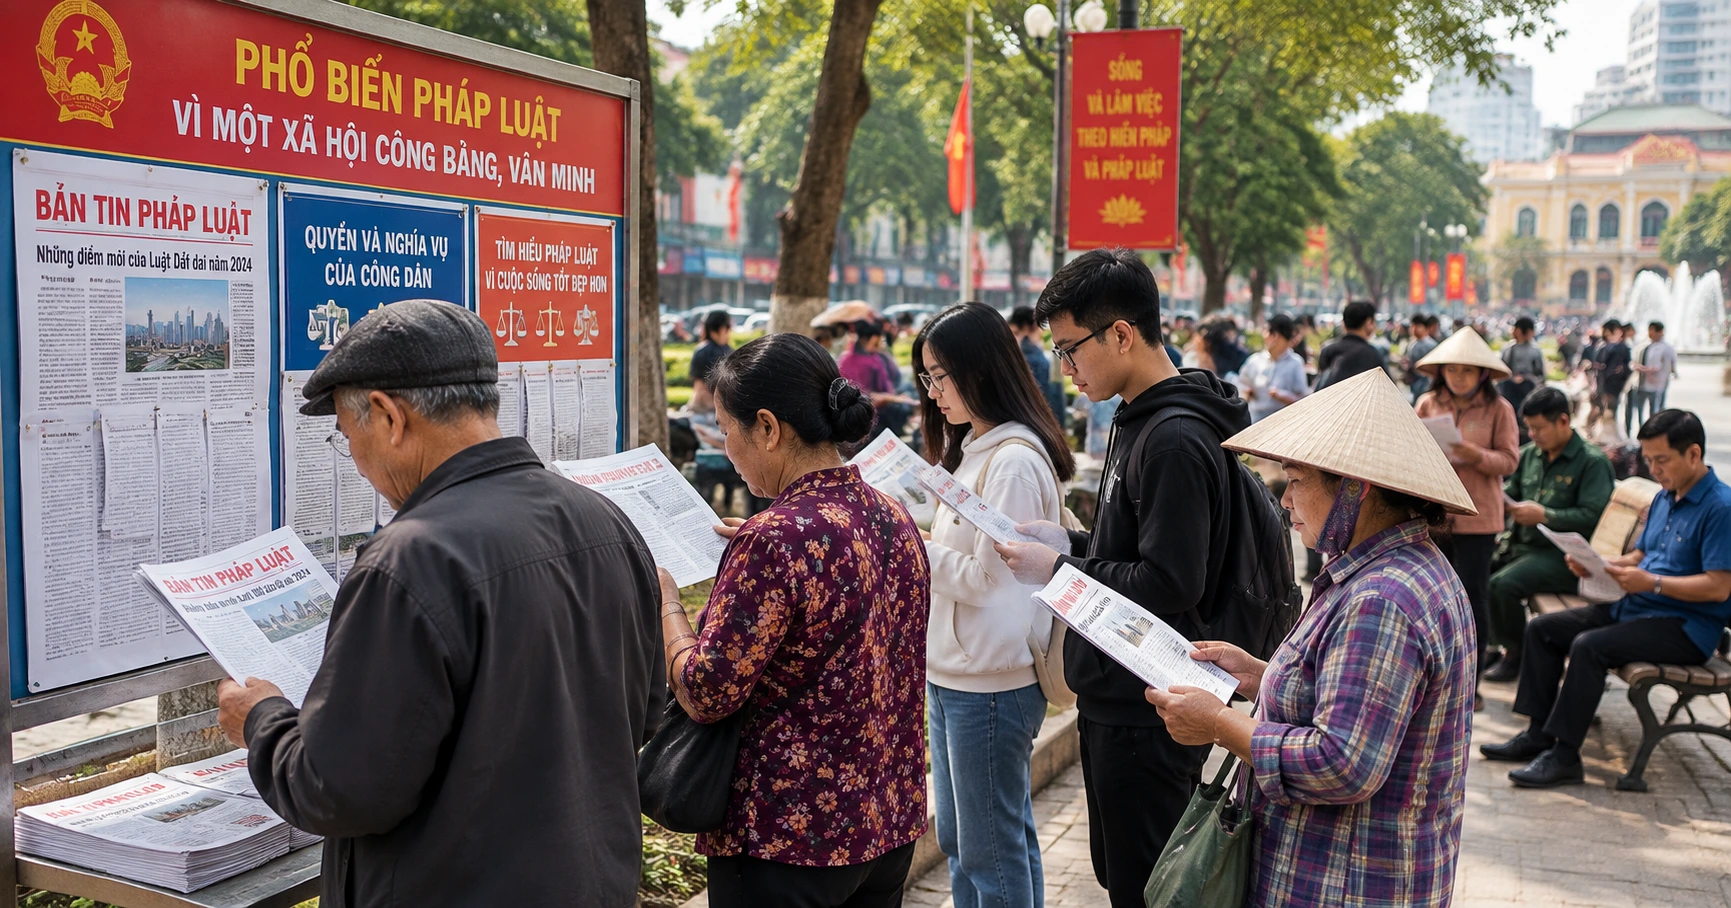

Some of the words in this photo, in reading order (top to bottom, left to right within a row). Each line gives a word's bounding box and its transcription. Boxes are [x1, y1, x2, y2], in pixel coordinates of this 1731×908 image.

[414, 77, 492, 129] PHÁP
[500, 95, 562, 149] LUẬT
[172, 93, 202, 138] VÌ
[212, 102, 273, 154] MỘT
[282, 113, 318, 155] XÃ
[326, 121, 367, 169] HỘI
[375, 129, 436, 172] CÔNG
[551, 162, 596, 195] MINH
[1076, 127, 1107, 149] THEO
[93, 194, 131, 227] TIN
[430, 235, 449, 262] VỤ
[495, 235, 516, 261] TÌM
[545, 240, 572, 264] PHÁP
[230, 255, 253, 273] 2024
[360, 258, 400, 288] CÔNG
[190, 573, 218, 592] TIN
